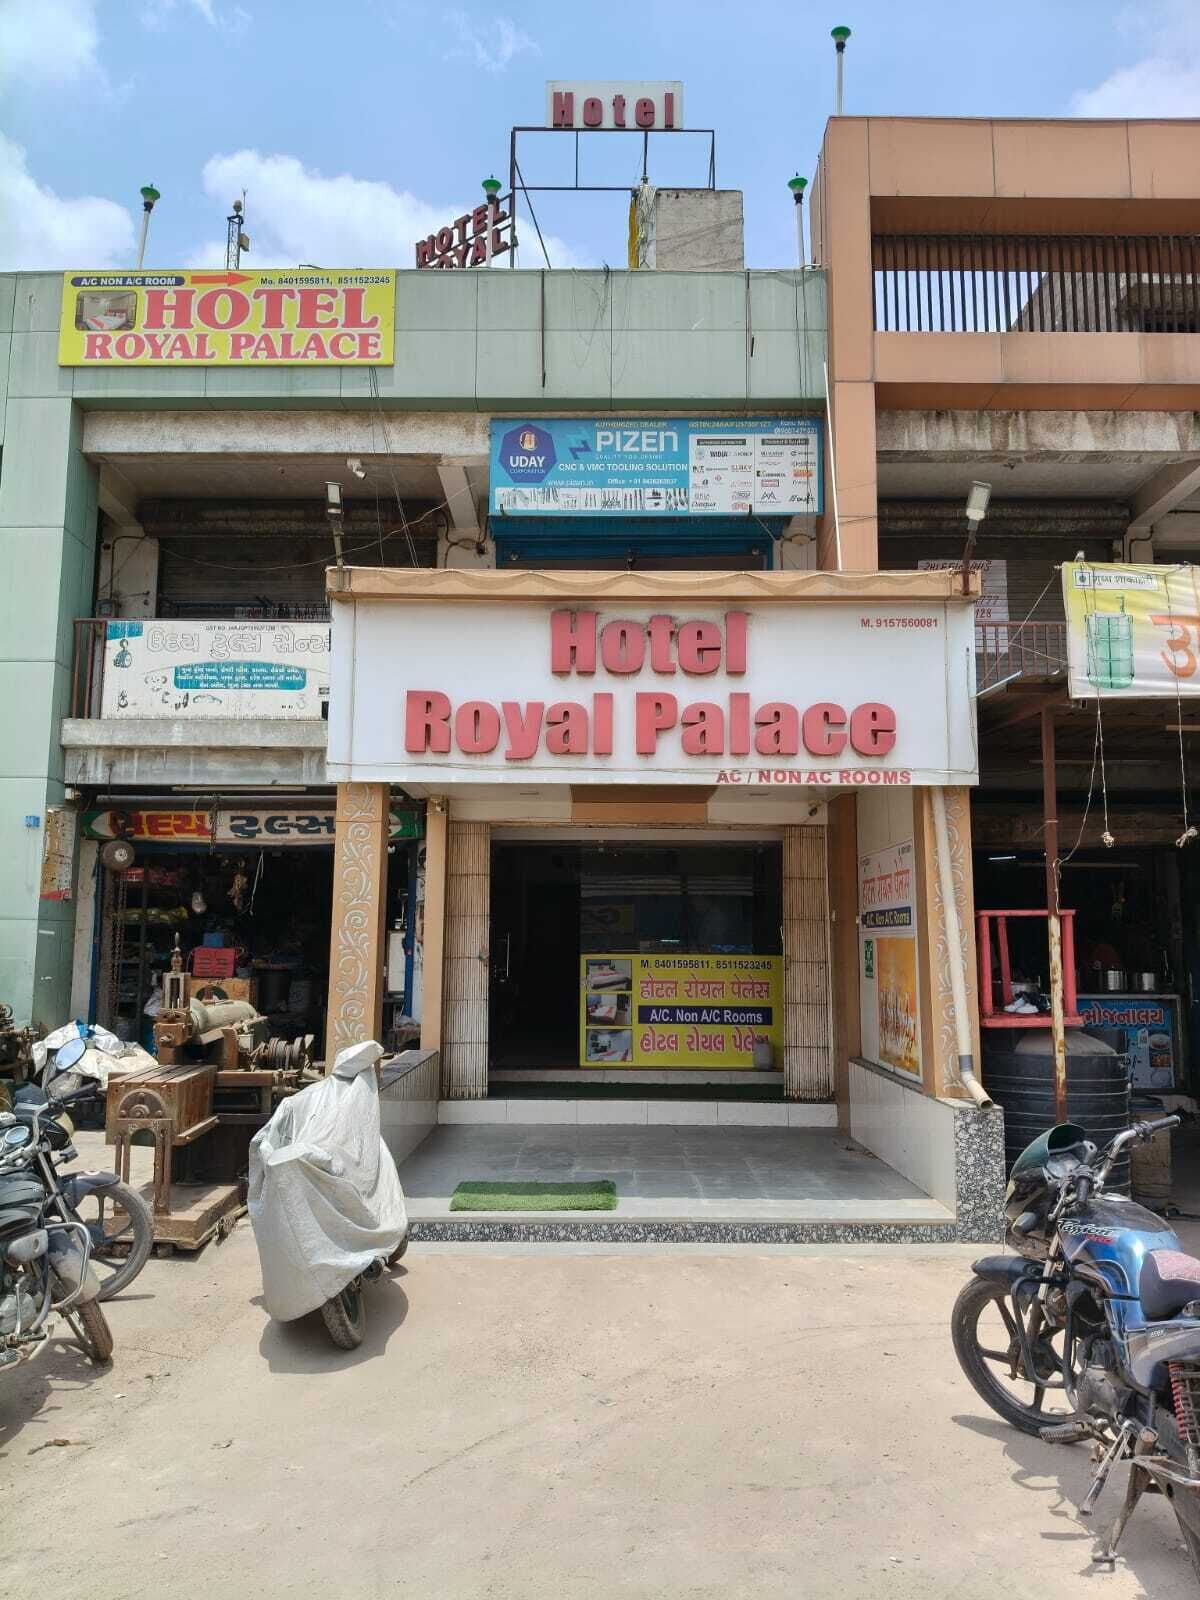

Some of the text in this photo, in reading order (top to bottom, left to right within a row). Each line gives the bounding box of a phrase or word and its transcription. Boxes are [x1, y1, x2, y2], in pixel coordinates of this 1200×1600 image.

[553, 92, 674, 128] Hotel
[81, 278, 97, 286] A/C
[100, 278, 124, 286] NON
[145, 277, 176, 285] ROOM
[143, 288, 379, 330] HOTEL
[84, 332, 381, 360] ROYAL PALACE
[509, 455, 545, 468] UDAY
[558, 463, 577, 472] CNC
[587, 463, 607, 472] VMC
[608, 463, 645, 472] TOOLING
[646, 463, 688, 472] SOLUTION
[861, 618, 938, 628] M. 9157560081
[551, 610, 748, 675] Hotel
[405, 690, 897, 760] Royal Palace
[716, 770, 742, 784] AC
[758, 769, 801, 784] NON
[807, 770, 832, 784] AC
[839, 770, 911, 784] ROOMS
[640, 959, 652, 969] M.
[716, 959, 772, 970] 8511523245
[640, 974, 770, 1000] होटल रोयल पेलेस
[650, 1009, 763, 1023] A/C. Non A/C Rooms
[639, 1026, 679, 1053] હોટલ
[685, 1026, 725, 1052] રોયલ
